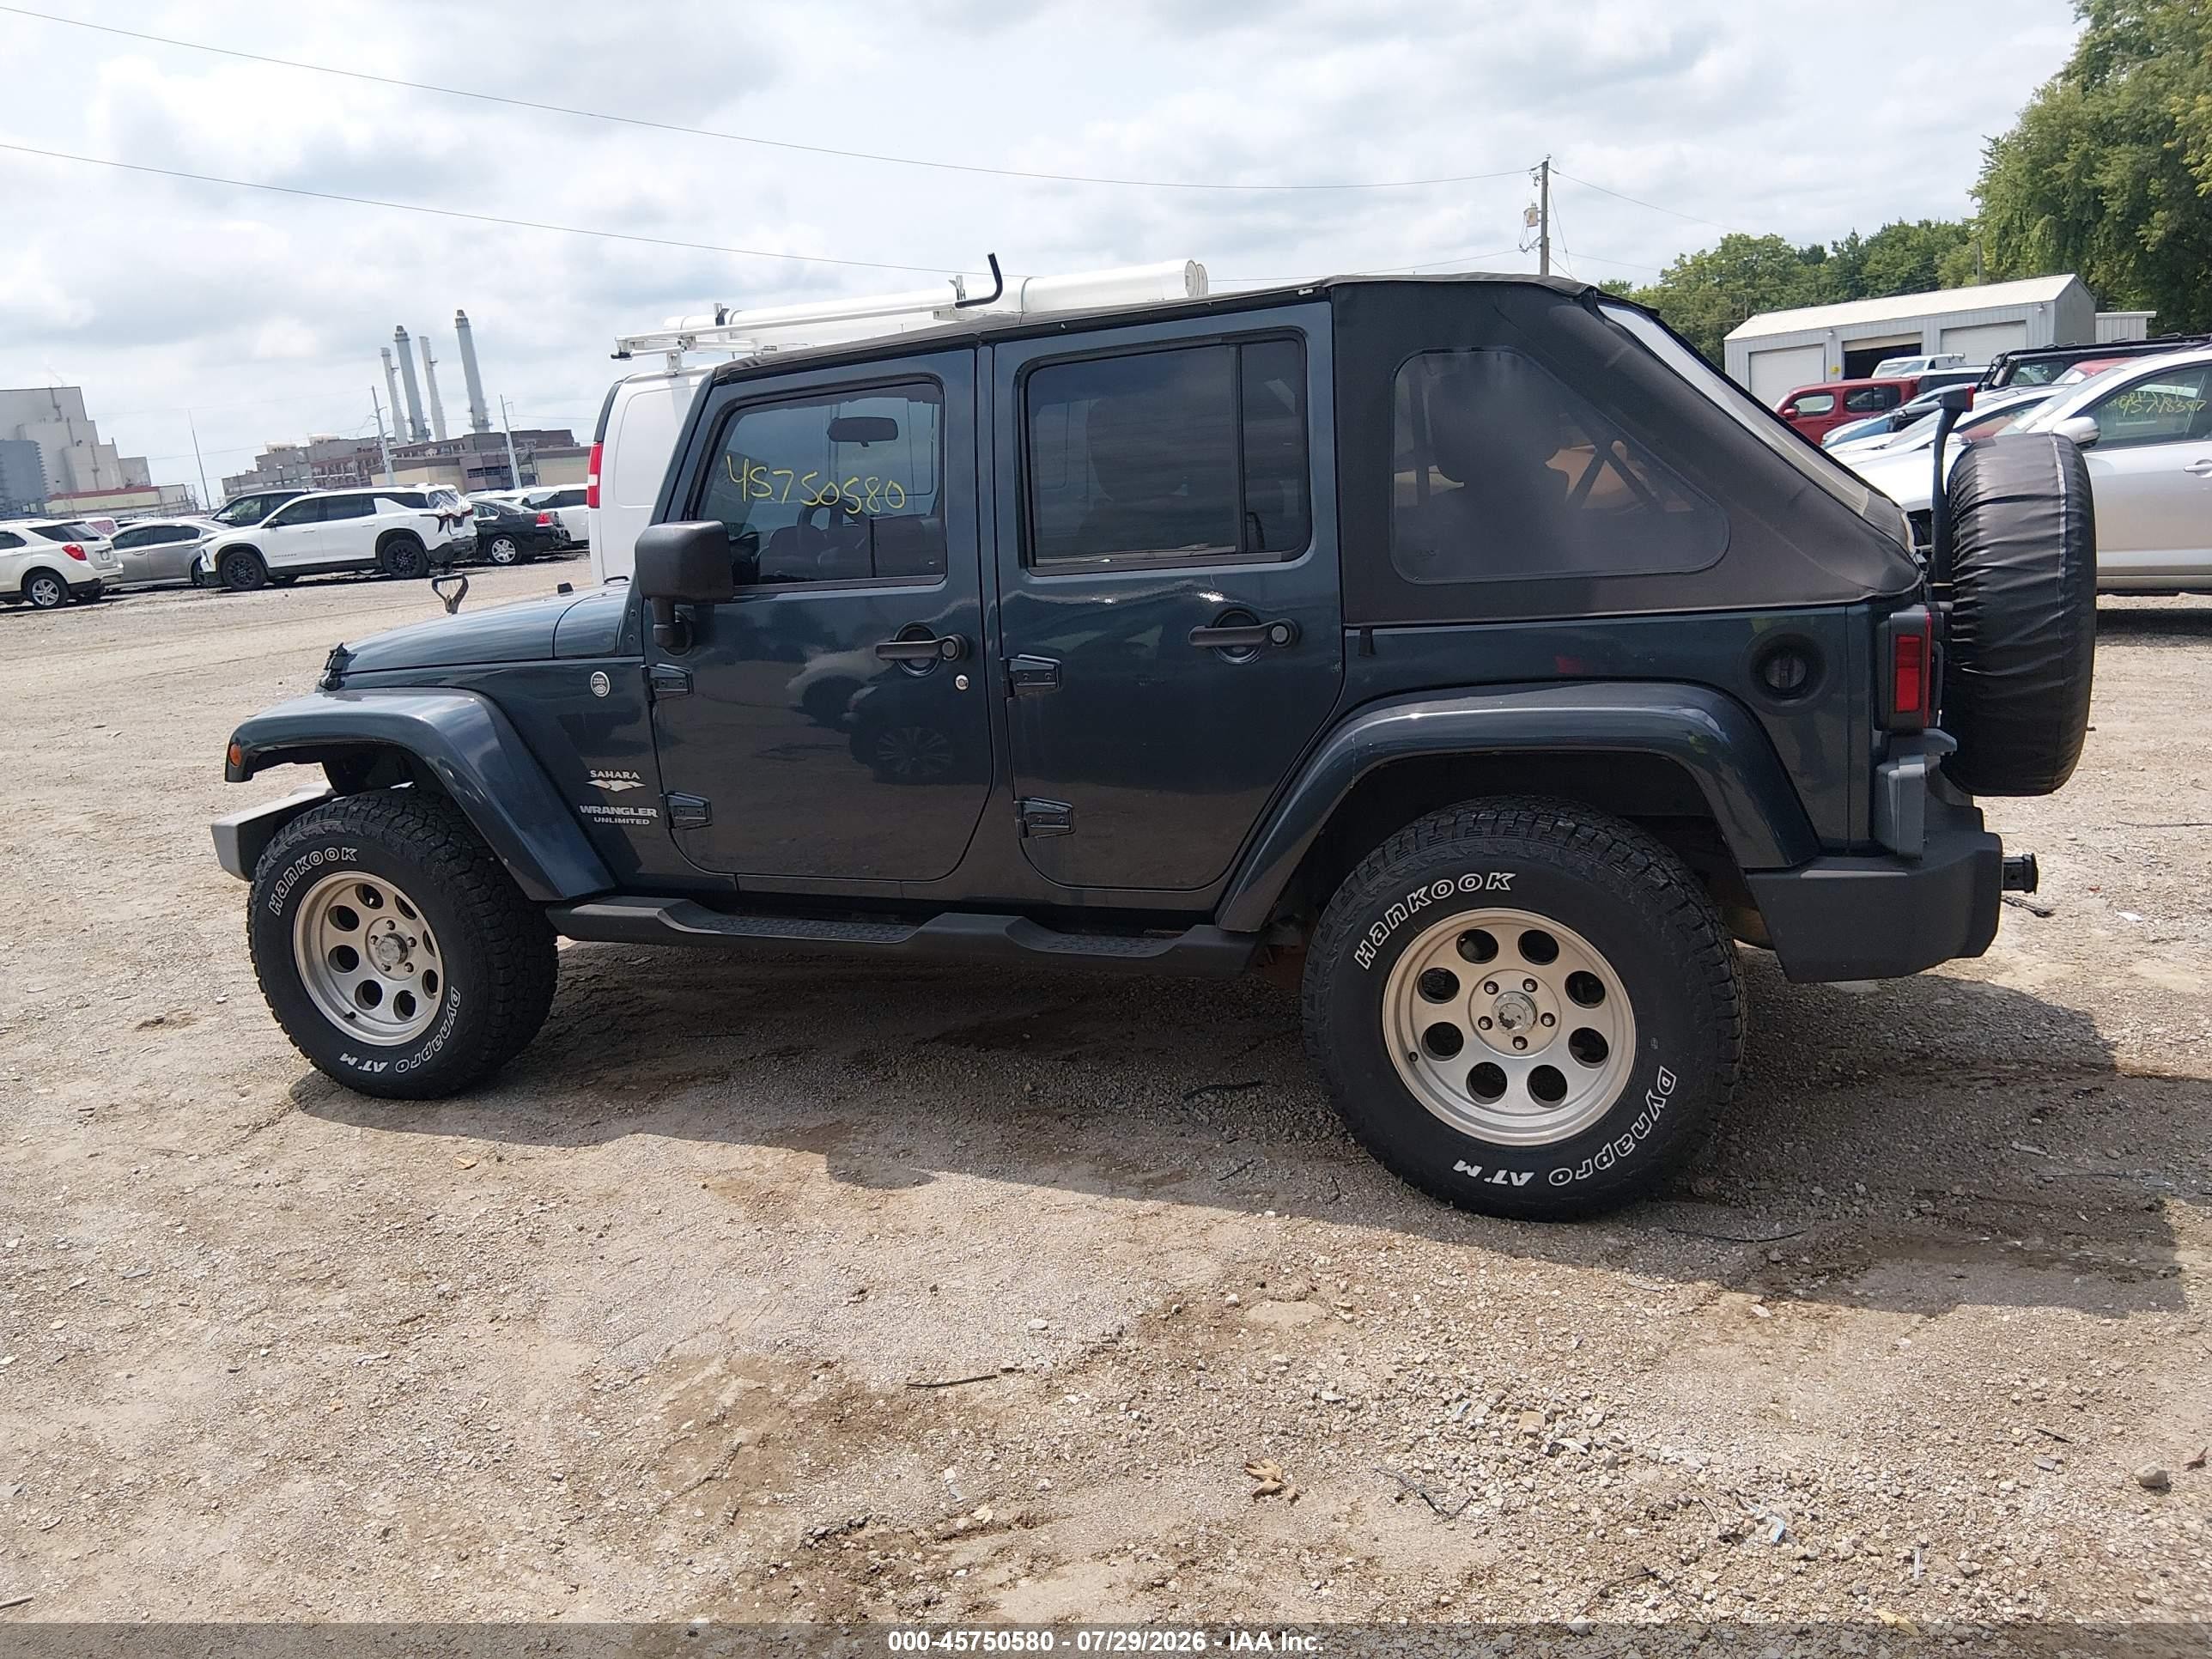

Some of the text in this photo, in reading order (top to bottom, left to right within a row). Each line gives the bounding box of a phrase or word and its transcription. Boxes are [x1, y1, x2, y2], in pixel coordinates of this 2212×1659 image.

[726, 454, 907, 514] 45750580
[590, 769, 641, 780] SAHARA
[579, 805, 659, 817] WRANGLER
[593, 817, 650, 825] UNLIMITED
[395, 986, 461, 1073] Dynapro
[1548, 1065, 1677, 1186] Dynapro
